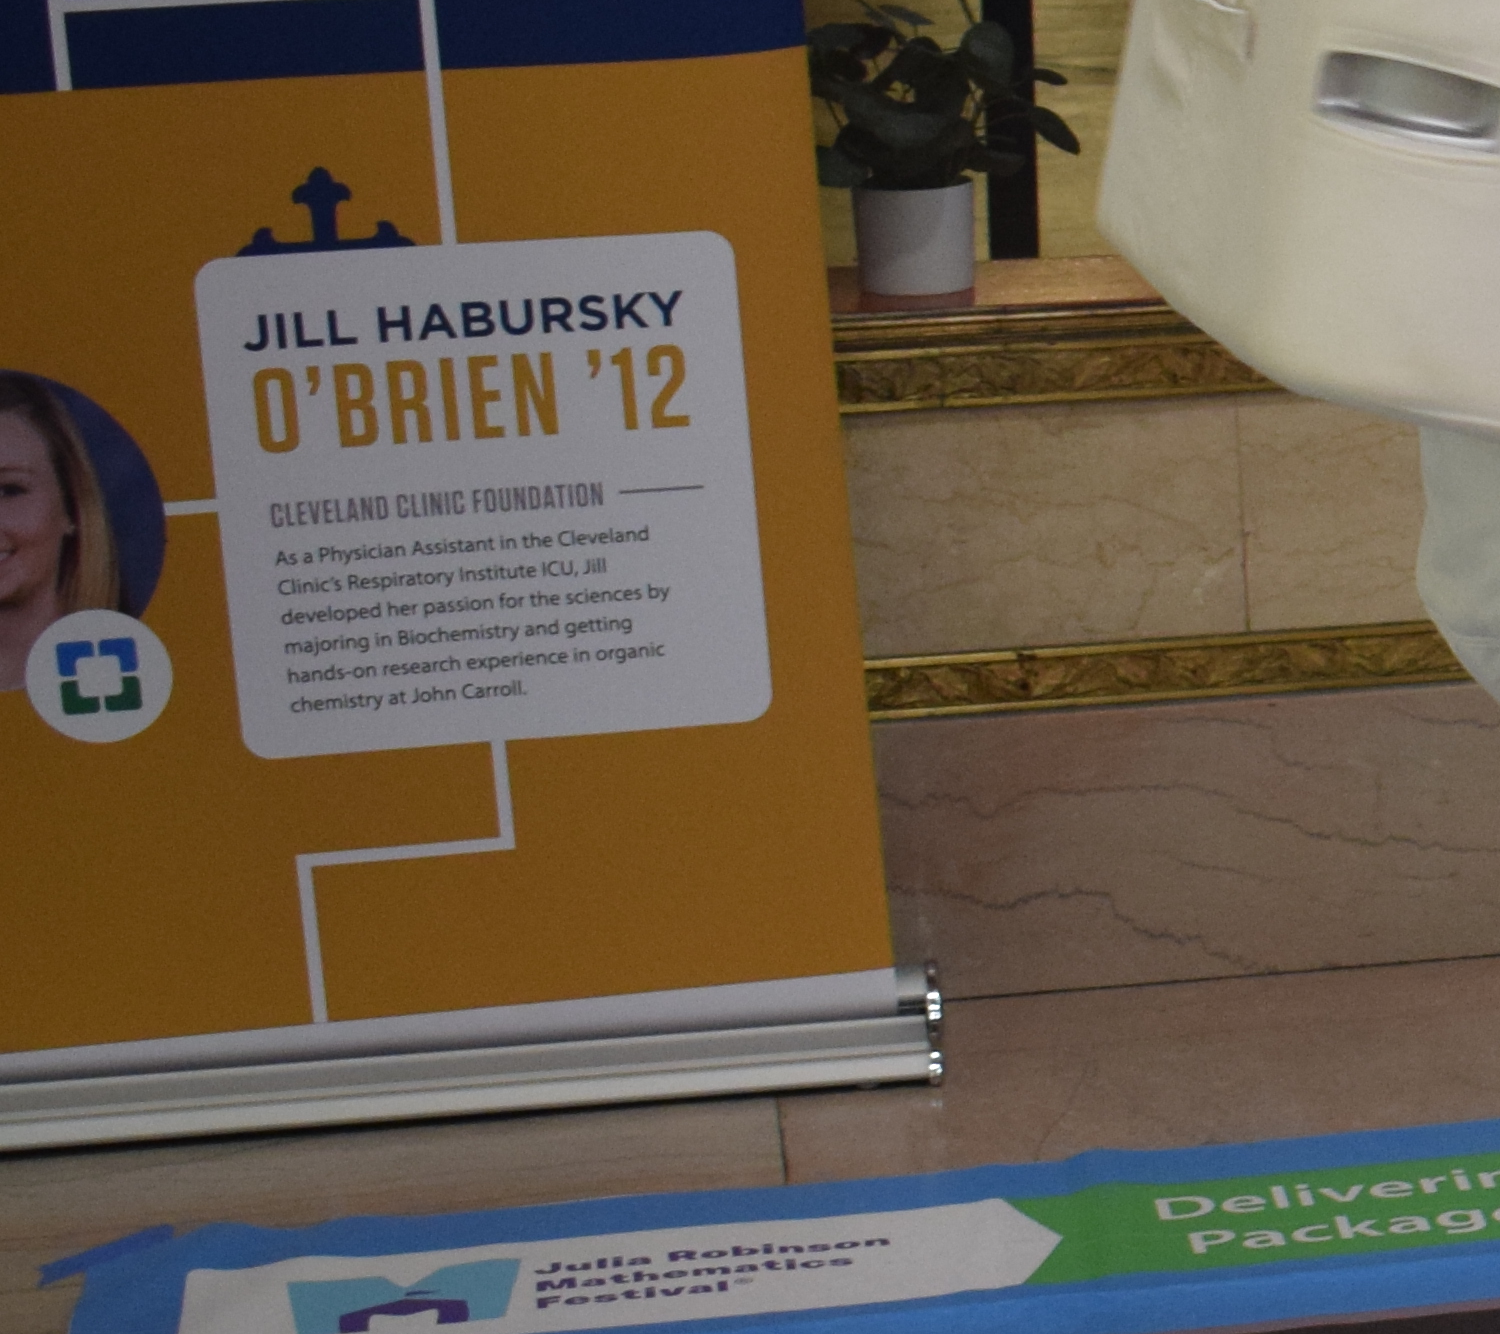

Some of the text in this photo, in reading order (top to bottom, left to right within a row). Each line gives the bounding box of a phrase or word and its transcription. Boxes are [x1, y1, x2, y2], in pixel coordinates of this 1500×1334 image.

[244, 290, 684, 352] JILL HABURSKY
[251, 344, 691, 454] O'BRIEN '12
[270, 481, 604, 528] CLEVELAND CLINIC FOUNDATION
[275, 525, 650, 567] As a Physician Assistant in the Cleveland
[534, 1236, 890, 1275] Julia Robinson
[535, 1257, 853, 1292] Mathematics
